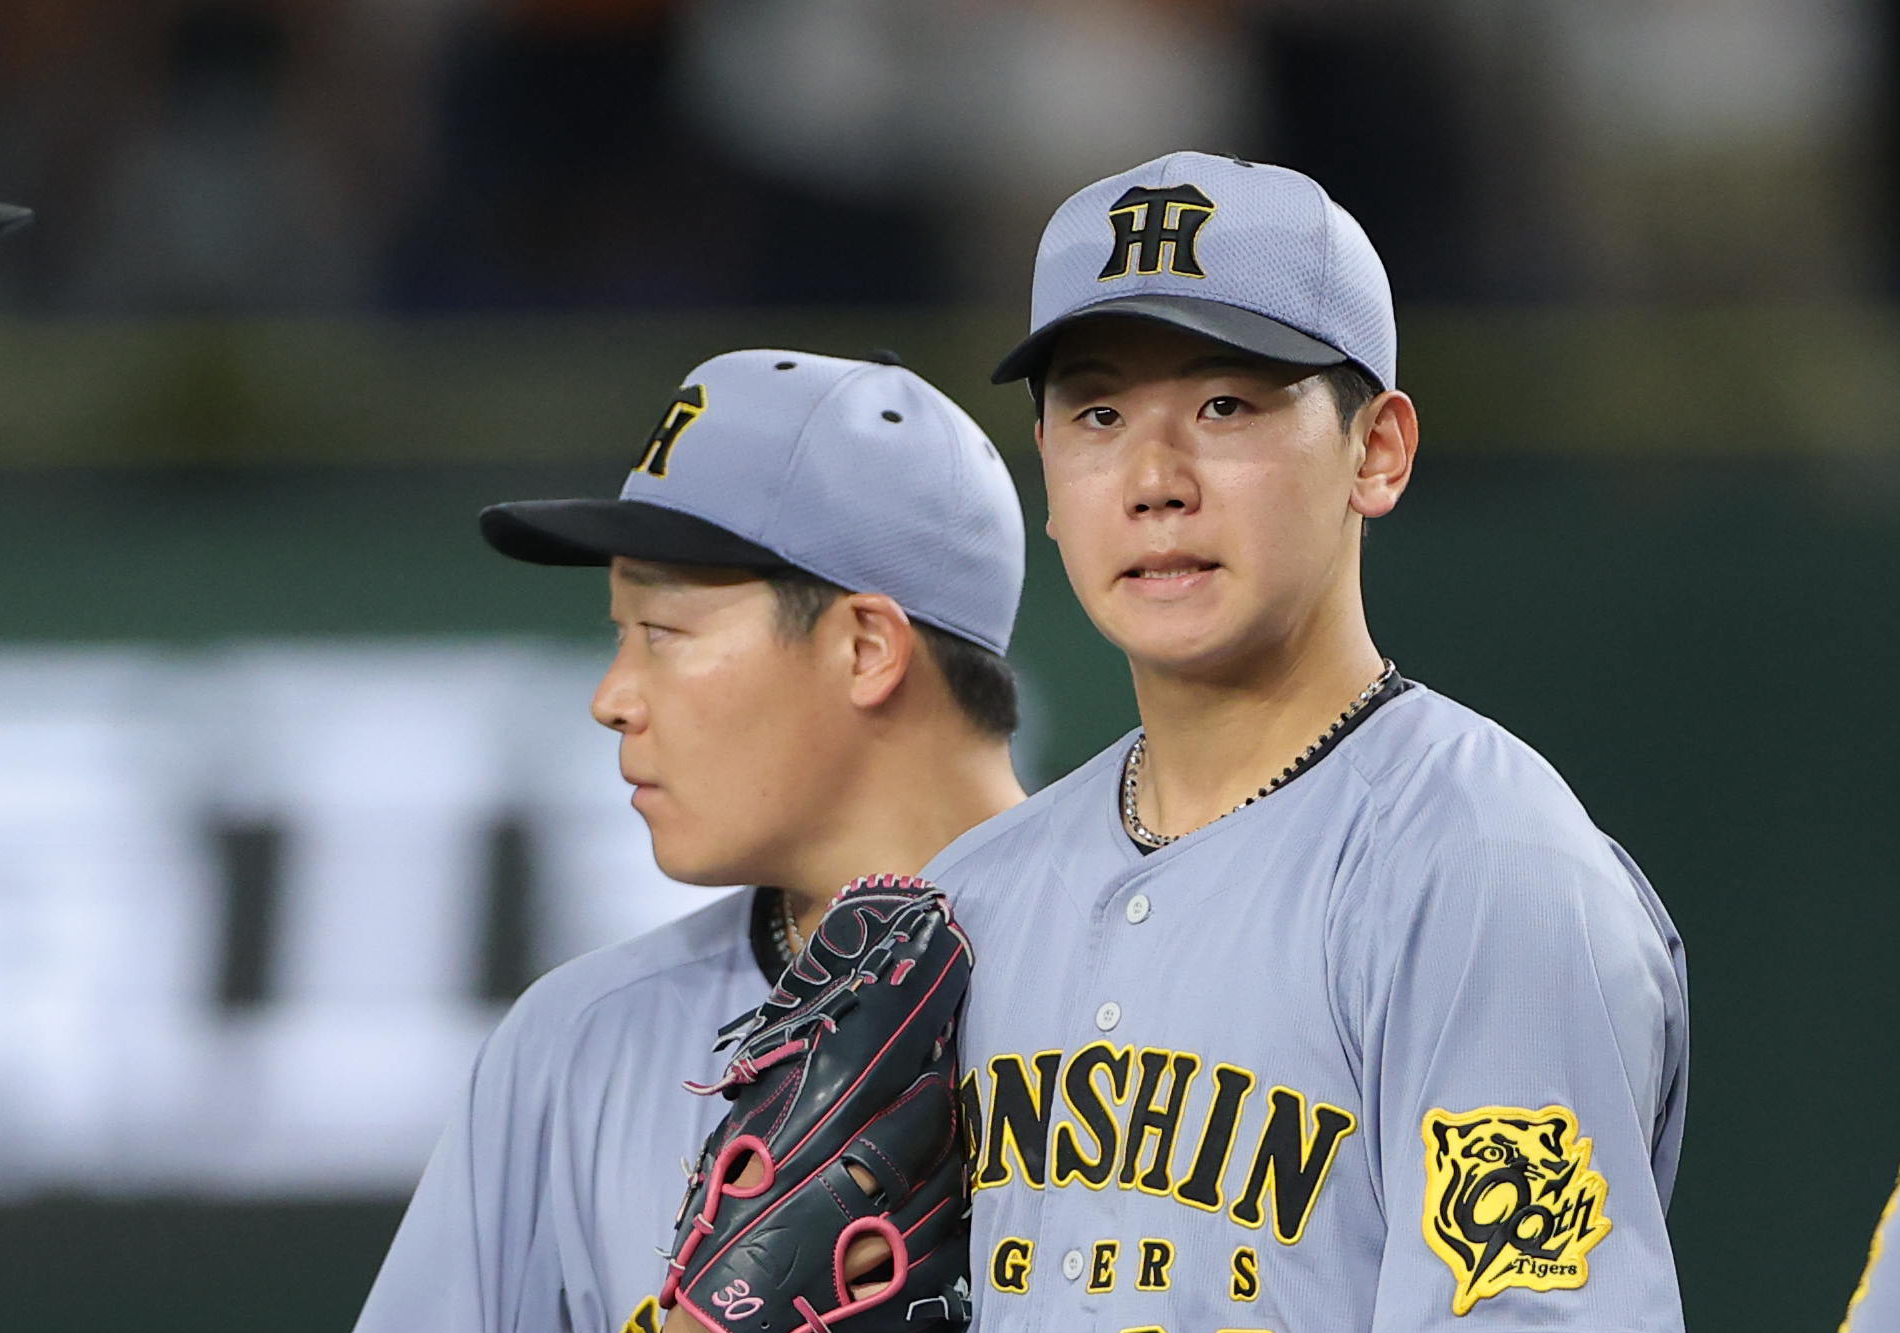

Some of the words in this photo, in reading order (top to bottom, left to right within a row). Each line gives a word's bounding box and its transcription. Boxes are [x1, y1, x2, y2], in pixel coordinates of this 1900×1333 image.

[959, 1039, 1358, 1246] NSHIN
[1514, 1258, 1578, 1278] Tigers
[711, 1279, 765, 1320] 30
